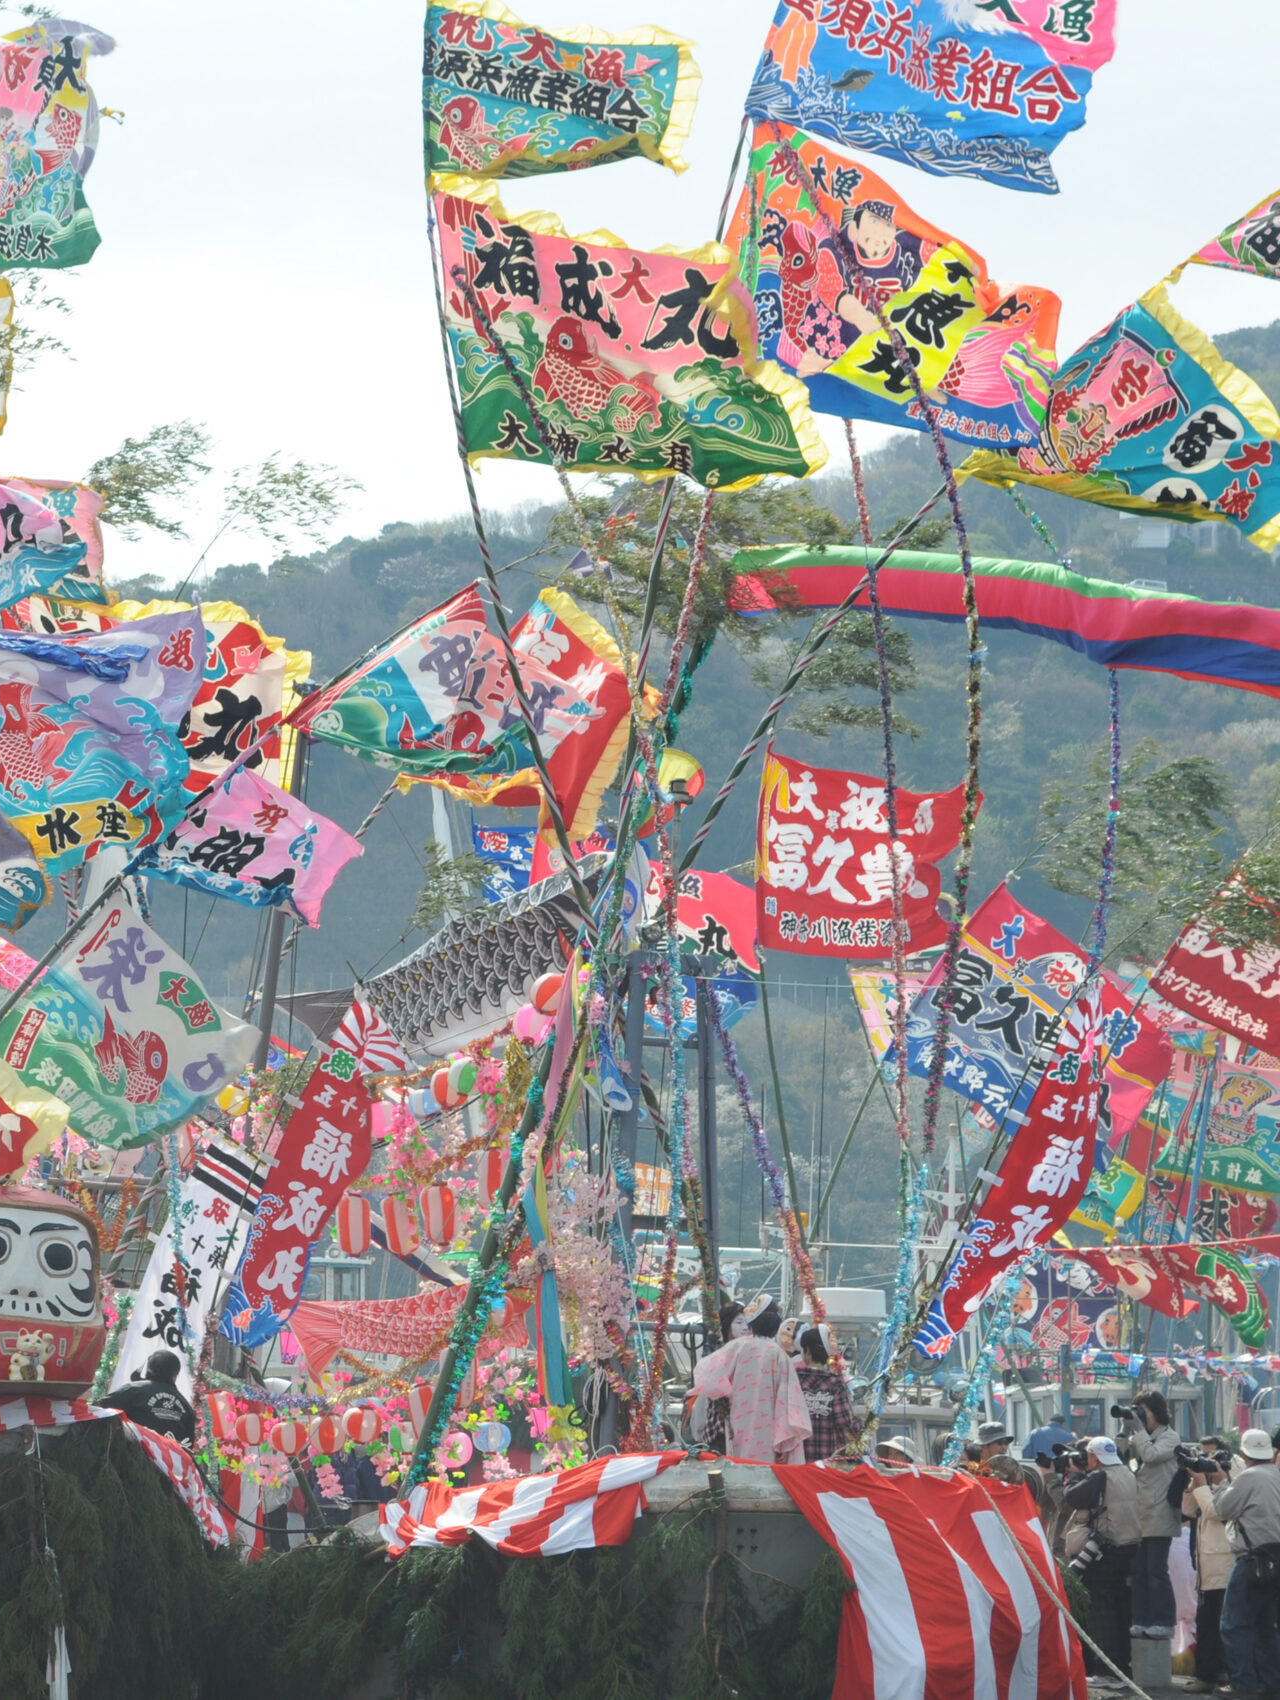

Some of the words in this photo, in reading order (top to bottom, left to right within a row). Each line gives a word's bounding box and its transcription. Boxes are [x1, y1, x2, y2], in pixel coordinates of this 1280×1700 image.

[424, 35, 651, 134] 須浜漁業組合
[610, 256, 655, 304] 大
[35, 799, 129, 849] 水産
[1159, 966, 1270, 1041] ホクモウ株式会社
